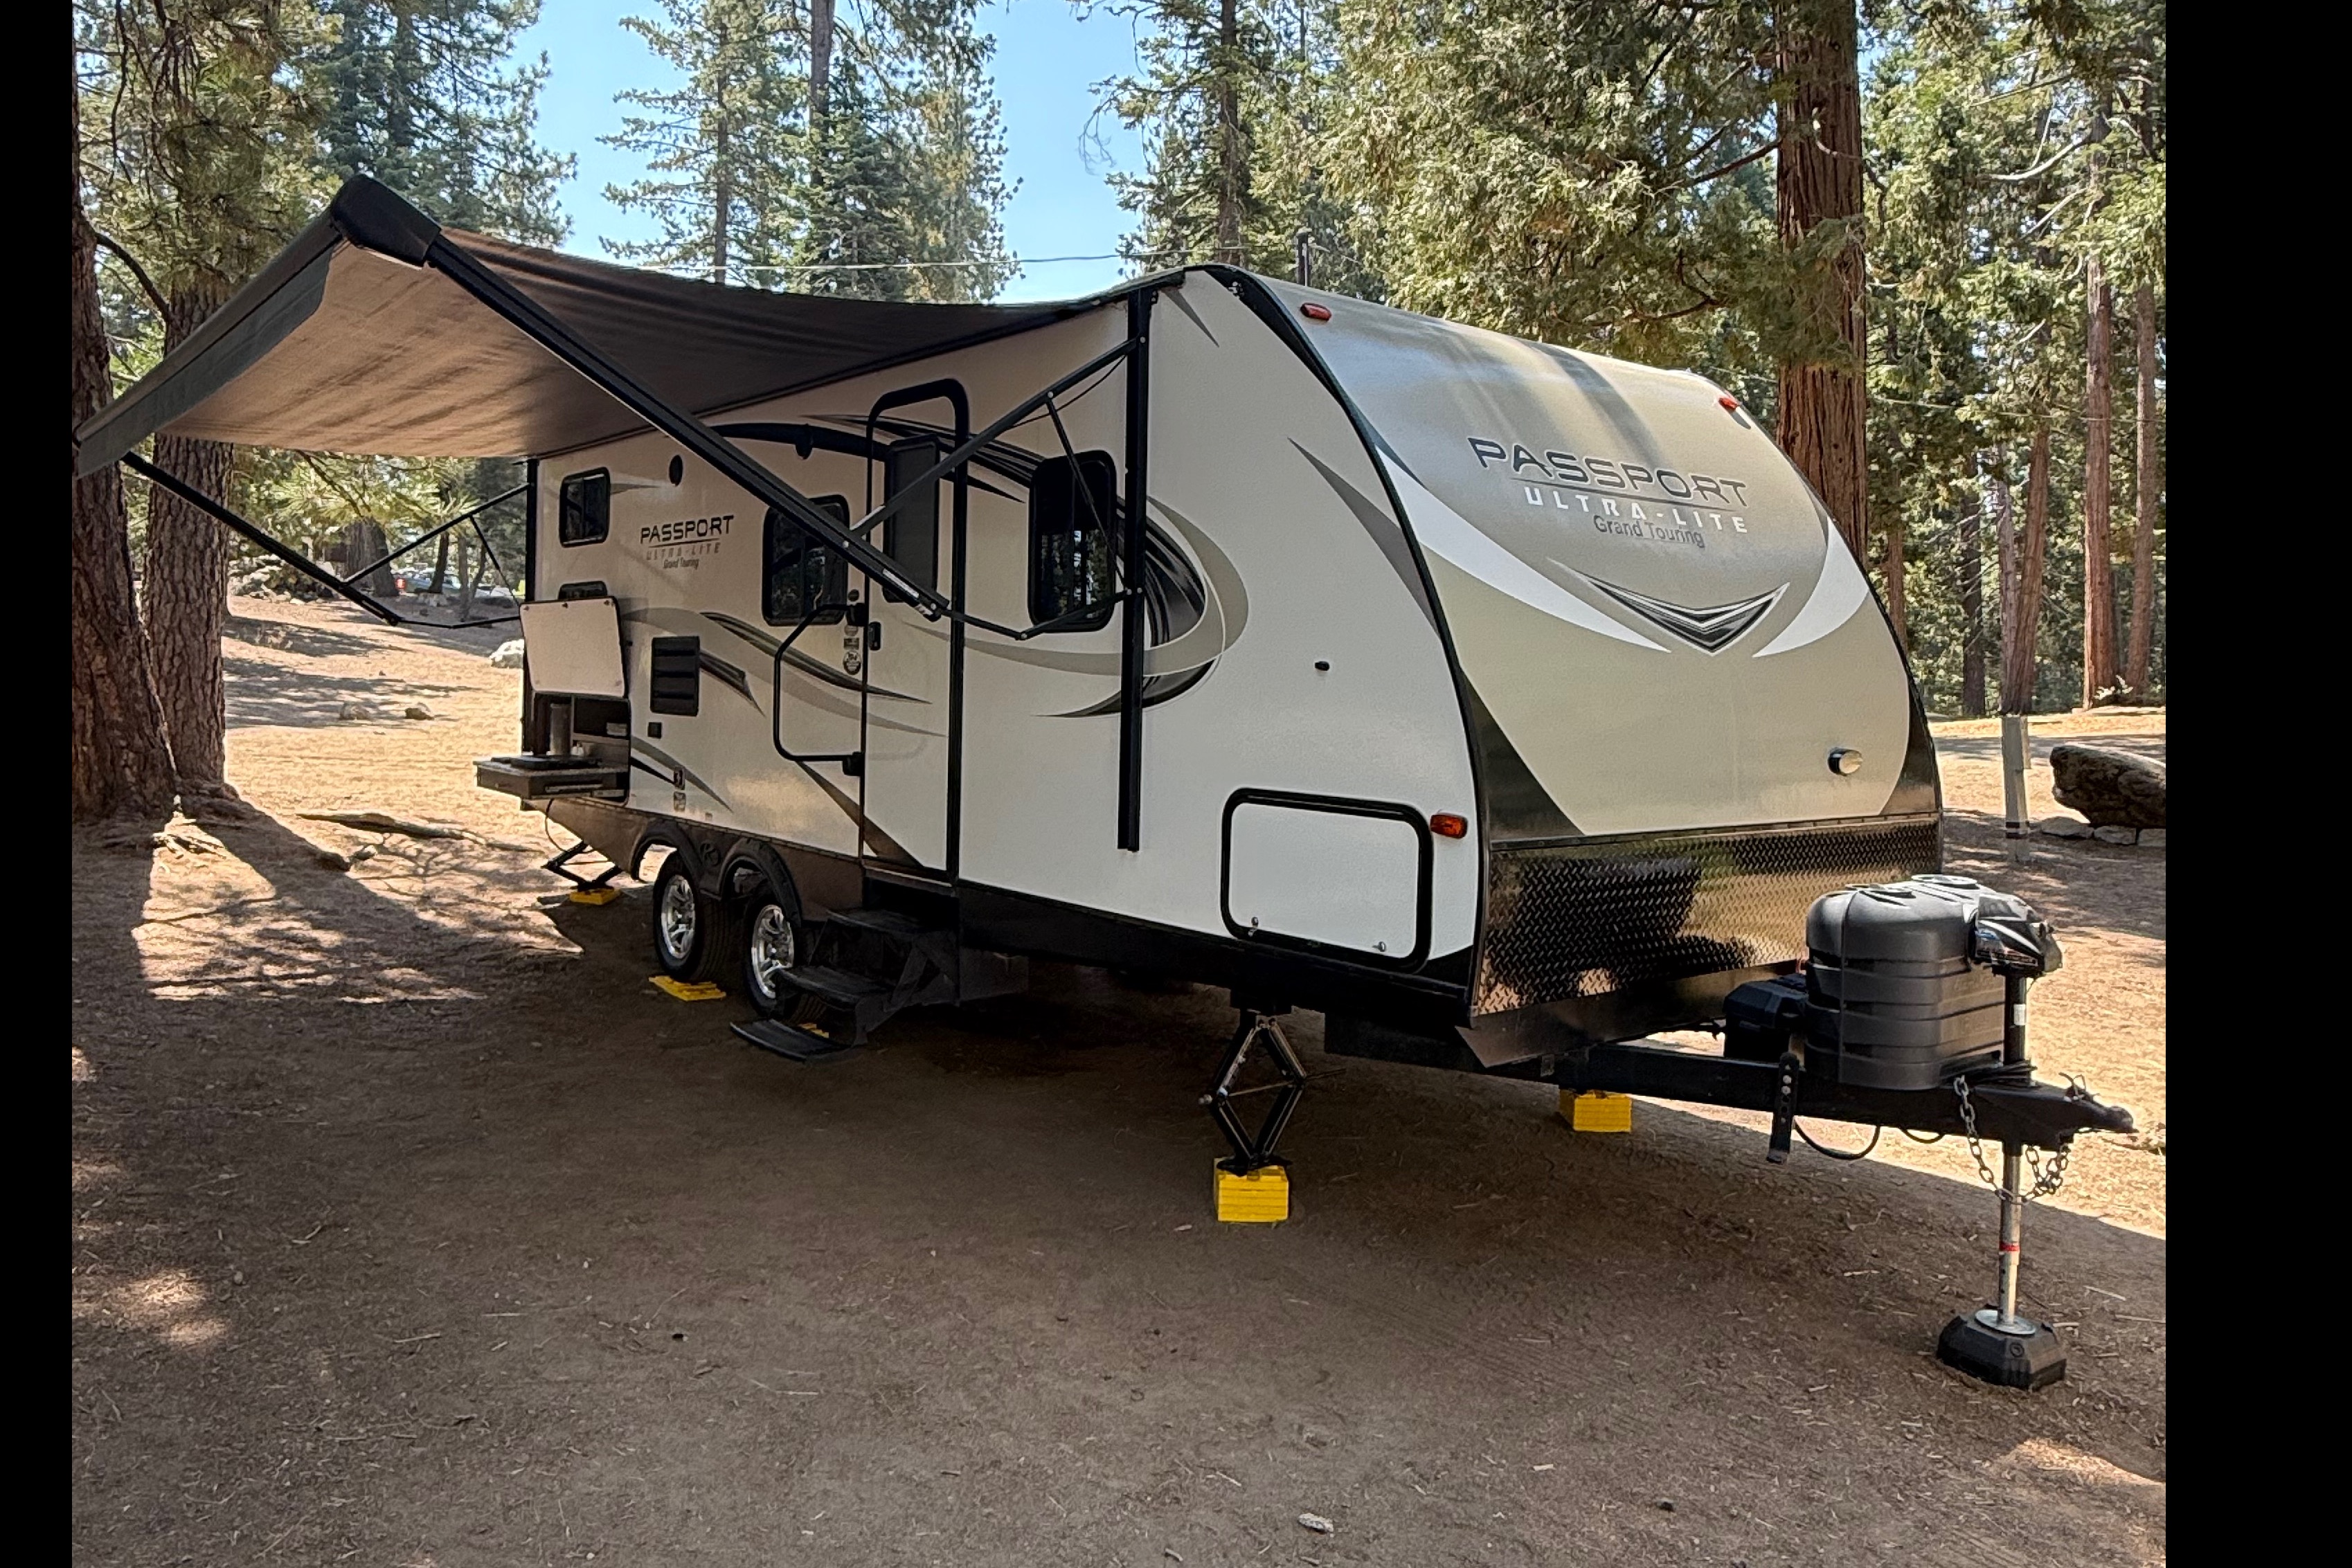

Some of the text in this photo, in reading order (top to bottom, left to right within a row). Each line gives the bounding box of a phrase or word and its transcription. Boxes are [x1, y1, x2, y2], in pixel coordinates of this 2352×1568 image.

[1467, 437, 1748, 507] PASSPORT
[640, 514, 734, 544] PASSPORT
[1525, 486, 1748, 533] ULTRA-LITE
[1593, 514, 1705, 548] Grand Touring
